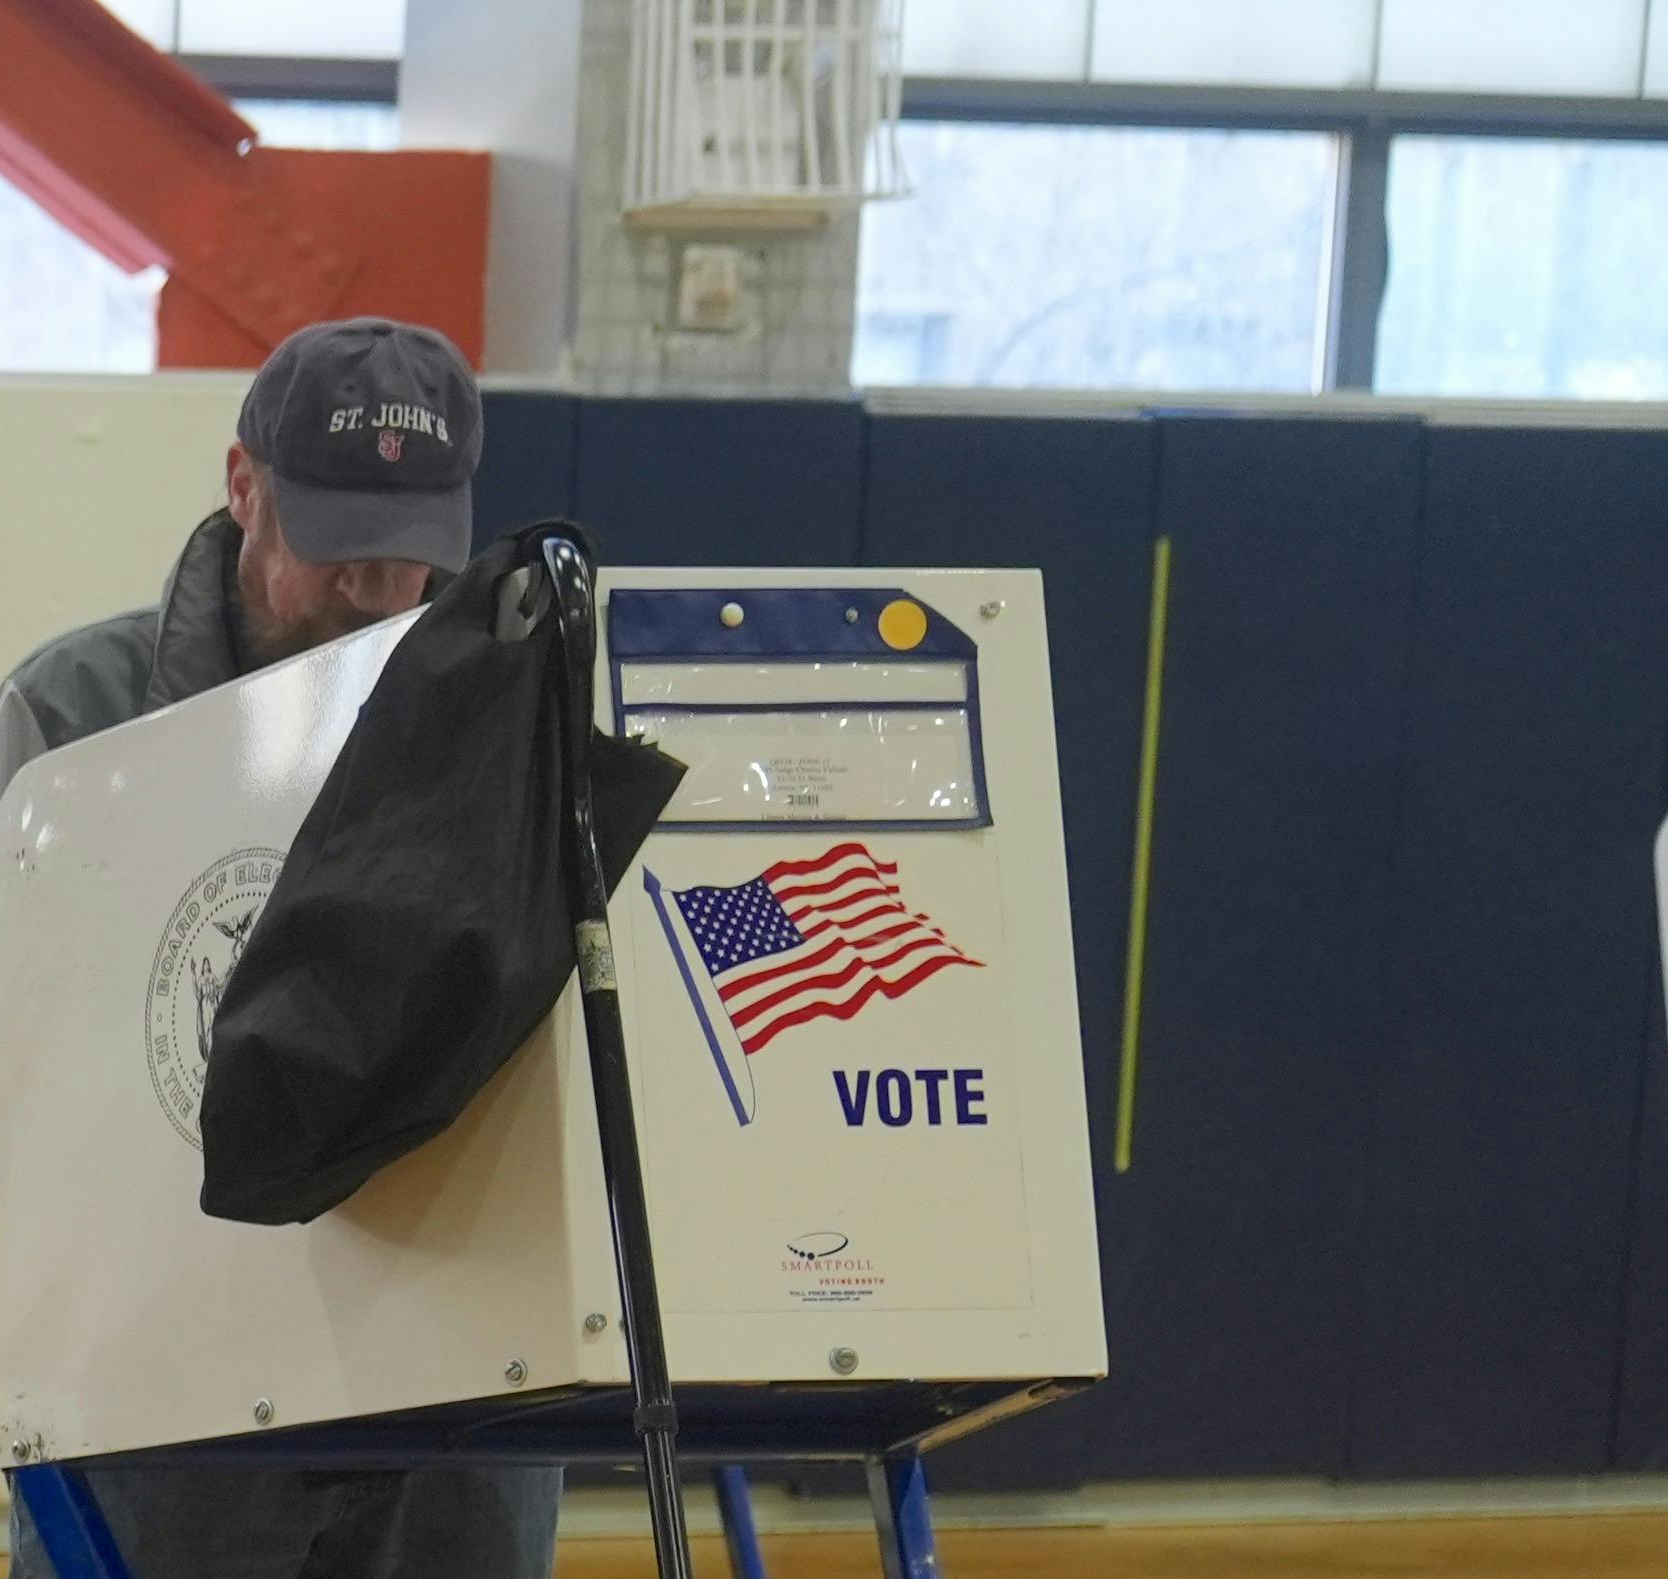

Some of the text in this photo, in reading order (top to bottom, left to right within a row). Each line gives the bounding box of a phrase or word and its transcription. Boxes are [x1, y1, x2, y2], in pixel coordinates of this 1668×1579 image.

[329, 402, 449, 442] ST. JOHN'S
[156, 901, 201, 997] BOARD
[203, 871, 228, 903] OF
[155, 1034, 194, 1120] IN THE
[832, 1069, 988, 1127] VOTE
[780, 1258, 874, 1272] SMARTPOLL
